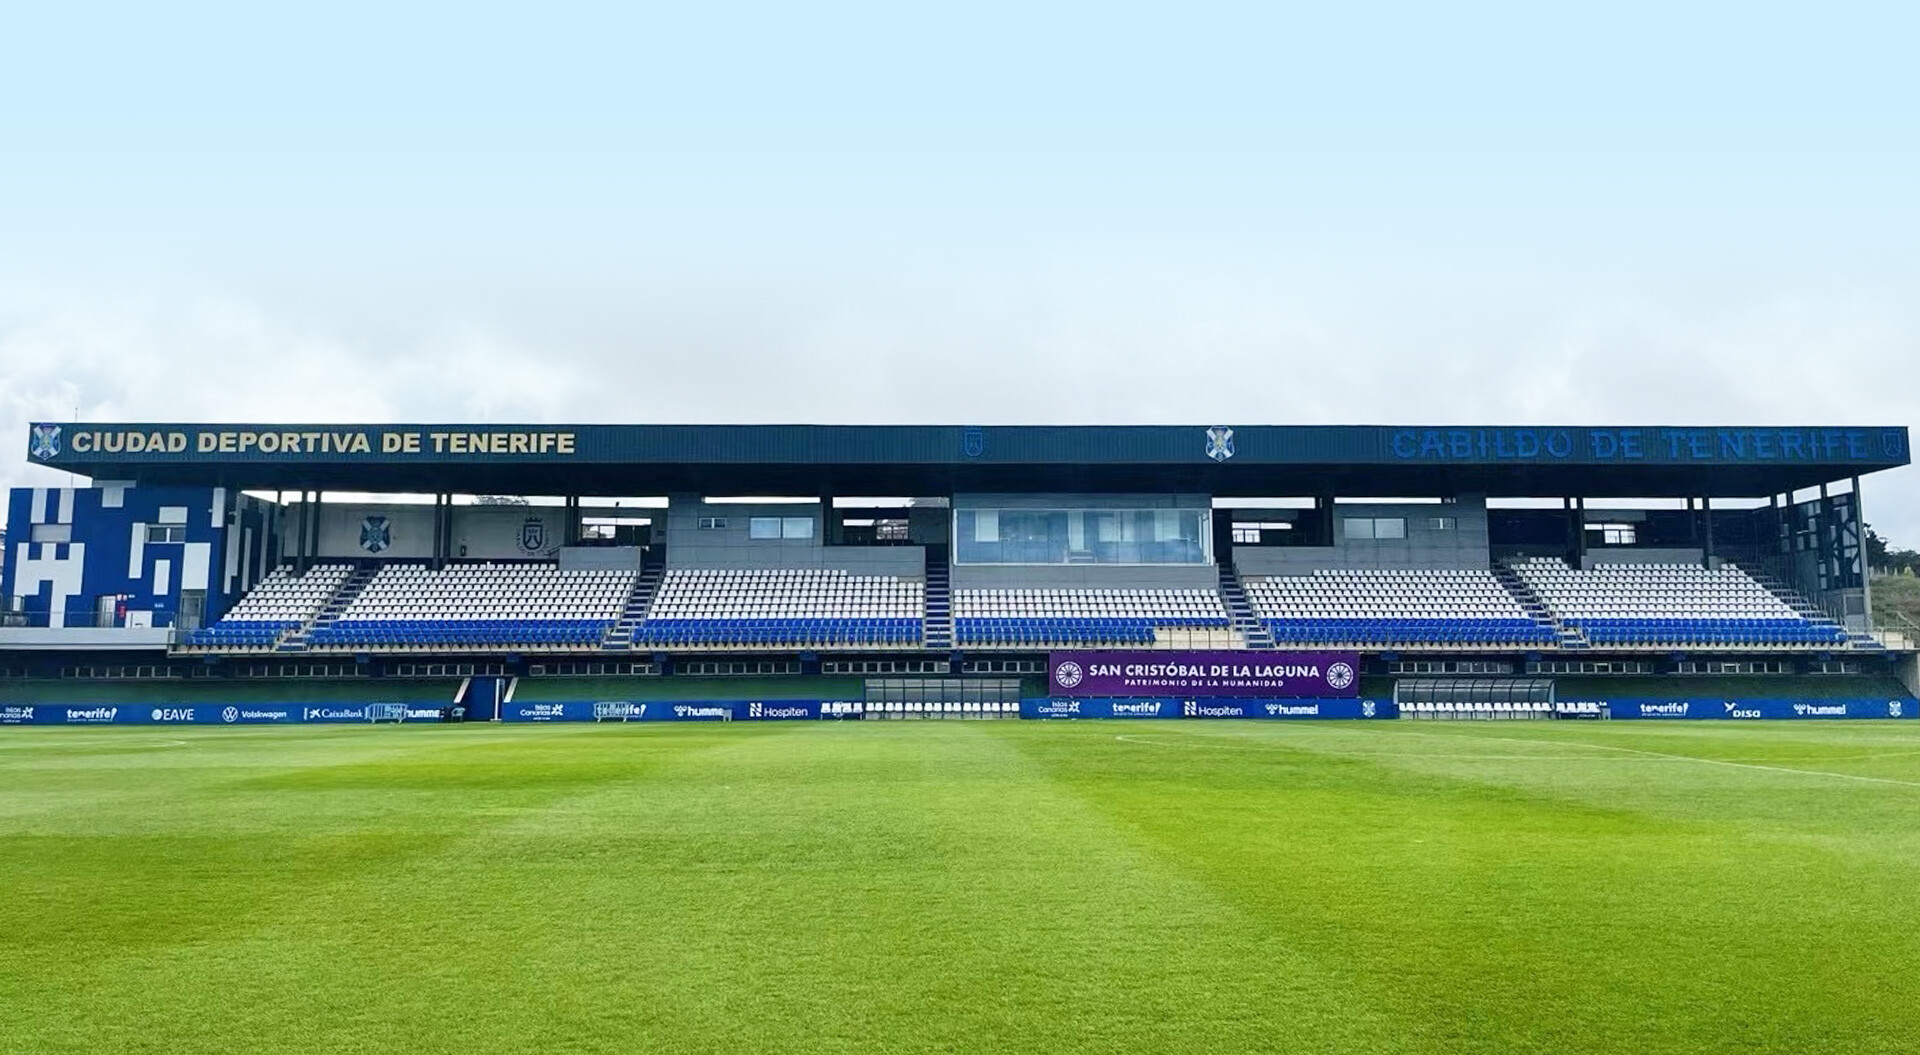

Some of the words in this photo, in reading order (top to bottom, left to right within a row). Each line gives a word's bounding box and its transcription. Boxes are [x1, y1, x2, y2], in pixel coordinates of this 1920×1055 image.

[72, 432, 187, 453] CIUDAD
[198, 432, 371, 453] DEPORTIVA
[382, 433, 420, 453] DE
[430, 433, 575, 453] TENERIFE
[1393, 430, 1572, 458] CABILDO
[1590, 430, 1643, 458] DE
[1662, 431, 1868, 458] TENERIFE
[1089, 664, 1121, 676] SAN
[1125, 661, 1206, 677] CRISTÓBAL
[1210, 665, 1229, 677] DE
[1233, 665, 1251, 677] LA
[1255, 665, 1320, 677] LAGUNA
[163, 708, 194, 720] EAVE
[322, 708, 363, 718] CaixaBank
[687, 705, 725, 716] humme
[764, 707, 808, 718] Hospiten
[1198, 706, 1243, 717] Hospiten
[1279, 704, 1319, 715] hummel
[1807, 704, 1846, 715] hummel
